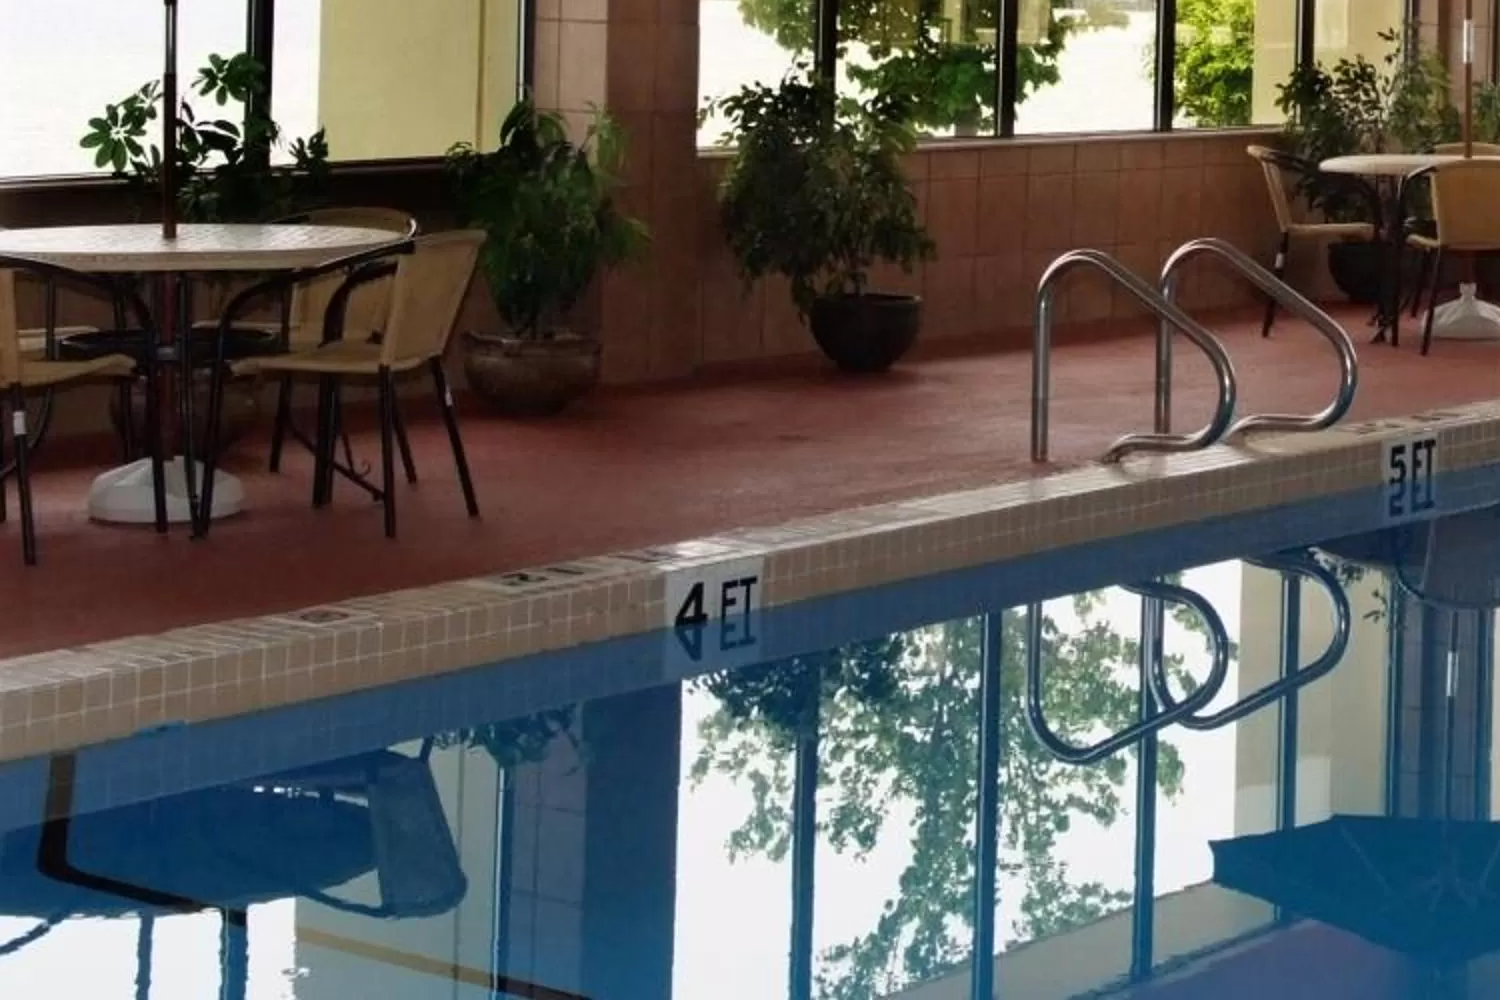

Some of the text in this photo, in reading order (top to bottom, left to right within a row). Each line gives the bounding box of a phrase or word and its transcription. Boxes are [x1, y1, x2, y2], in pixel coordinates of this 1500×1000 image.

[1389, 438, 1437, 485] 5 FT
[674, 575, 758, 627] 4 FT
